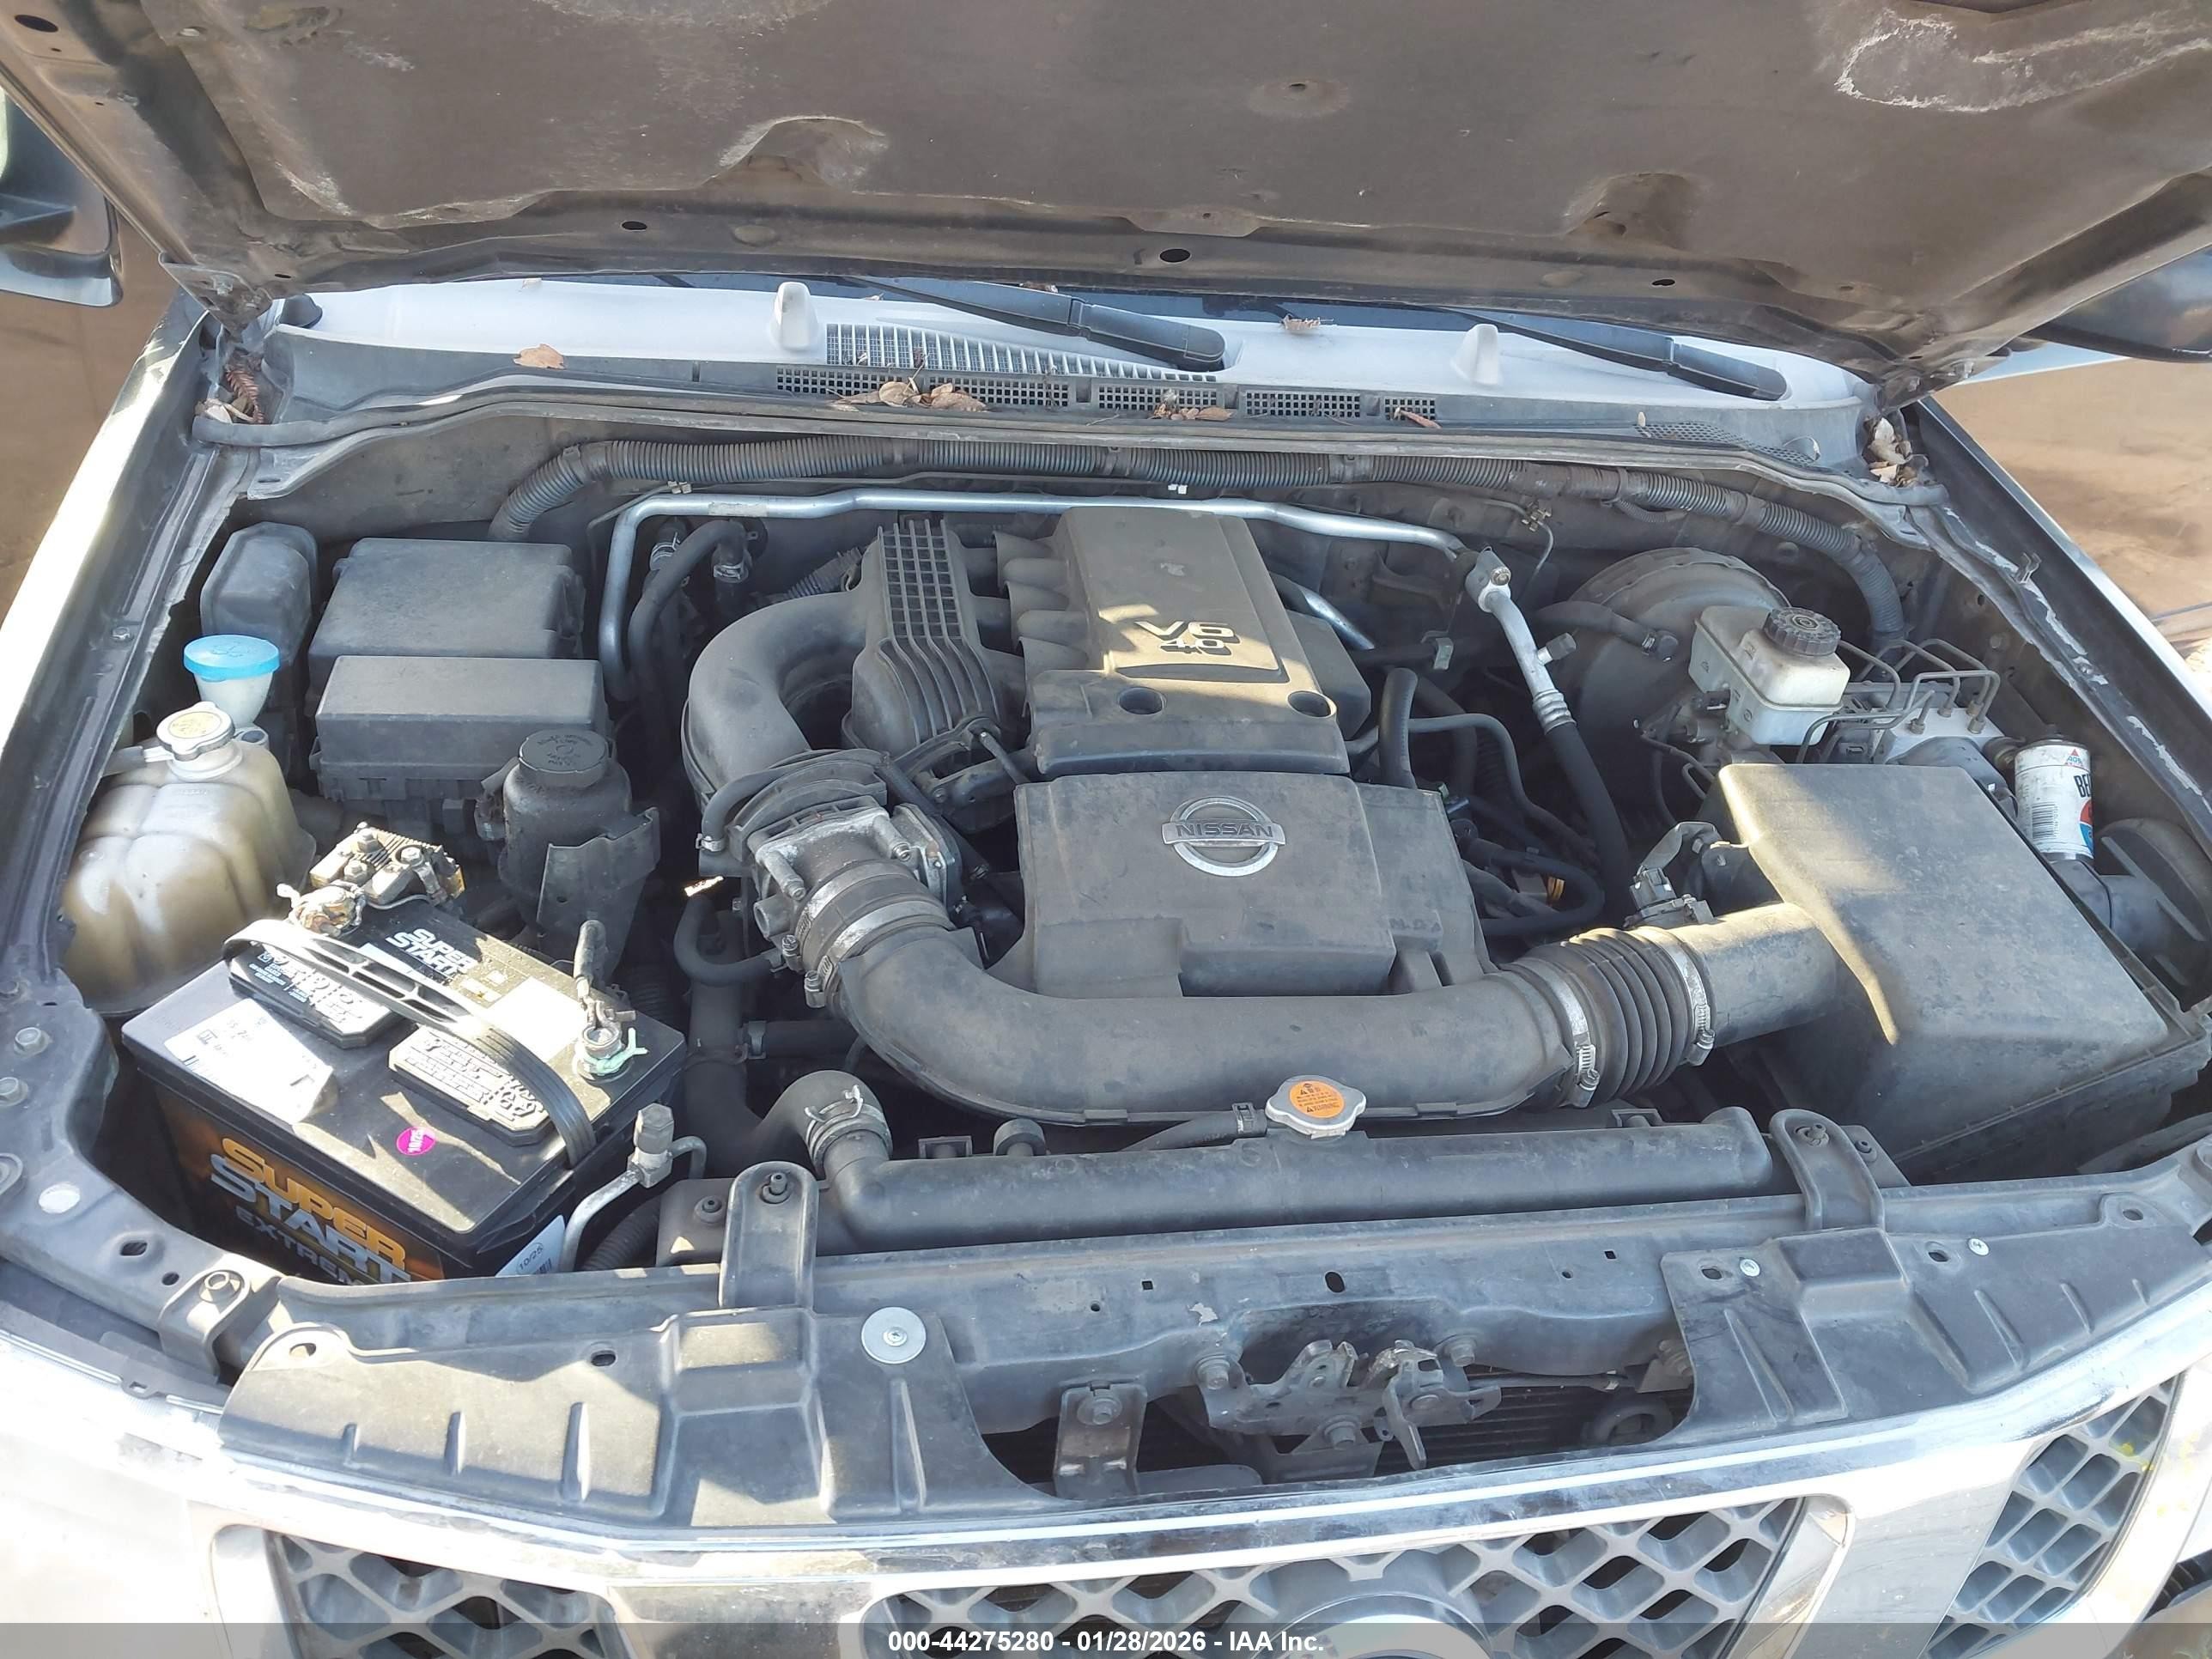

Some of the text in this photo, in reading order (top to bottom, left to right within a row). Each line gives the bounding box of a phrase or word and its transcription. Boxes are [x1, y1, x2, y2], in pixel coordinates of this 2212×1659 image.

[1133, 620, 1237, 641] V6
[1175, 822, 1274, 838] NISSAN
[385, 932, 460, 978] START
[412, 927, 478, 974] SUPER
[211, 1154, 412, 1283] START
[222, 1138, 406, 1271] SUPER
[519, 1245, 544, 1270] 10/25
